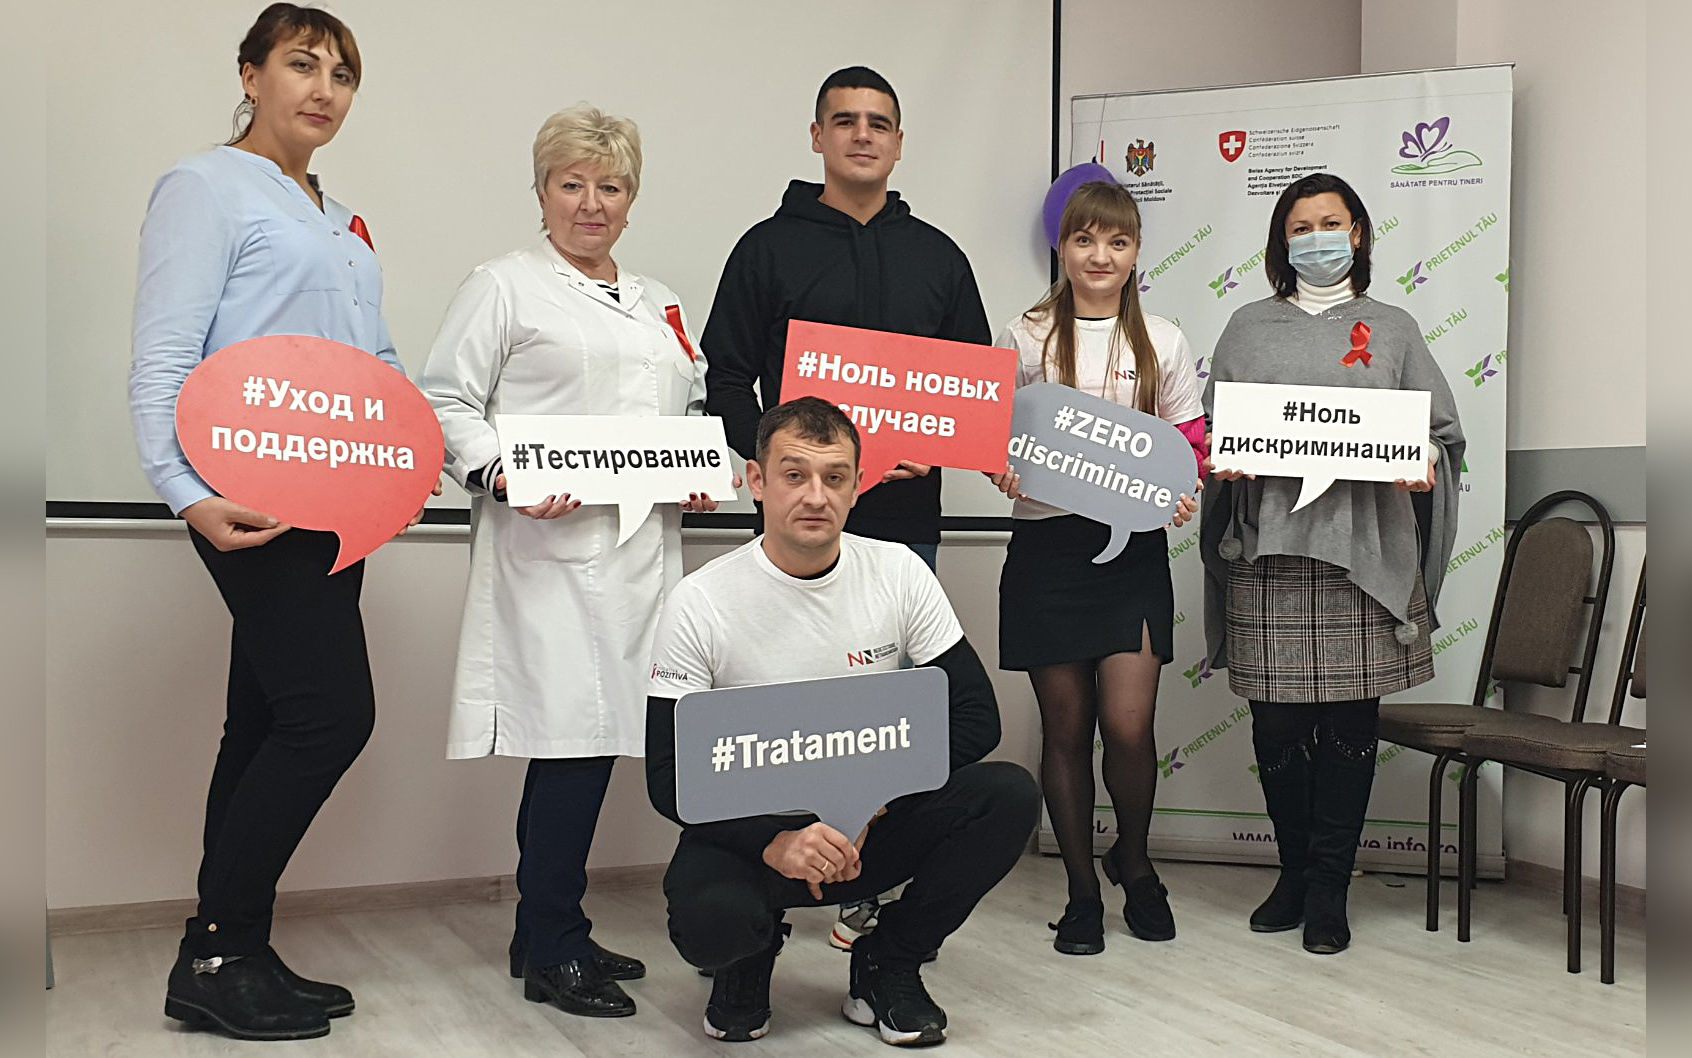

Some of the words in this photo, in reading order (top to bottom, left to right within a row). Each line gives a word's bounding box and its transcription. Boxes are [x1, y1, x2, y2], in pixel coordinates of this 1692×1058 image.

[1428, 179, 1458, 187] PENTRU
[1460, 178, 1484, 186] TINERI
[1377, 216, 1399, 235] TĂU
[1425, 230, 1478, 271] PRIETENUL
[1475, 212, 1498, 232] TĂU
[1148, 240, 1195, 281] PRIETENUL
[1192, 224, 1213, 243] TĂU
[1445, 308, 1468, 328] TĂU
[797, 351, 896, 388] #Ноль
[905, 371, 1000, 402] новых
[242, 375, 354, 422] #Уход
[364, 397, 384, 421] и
[1282, 401, 1361, 425] #Ноль
[211, 426, 415, 470] поддержка
[1053, 405, 1153, 458] #ZERO
[1218, 436, 1421, 463] дискриминации
[513, 443, 721, 475] #Тестирование
[1008, 429, 1172, 508] discriminare
[1456, 618, 1479, 637] TĂU
[711, 717, 911, 772] #Tratament
[1182, 719, 1232, 757] PRIETENUL
